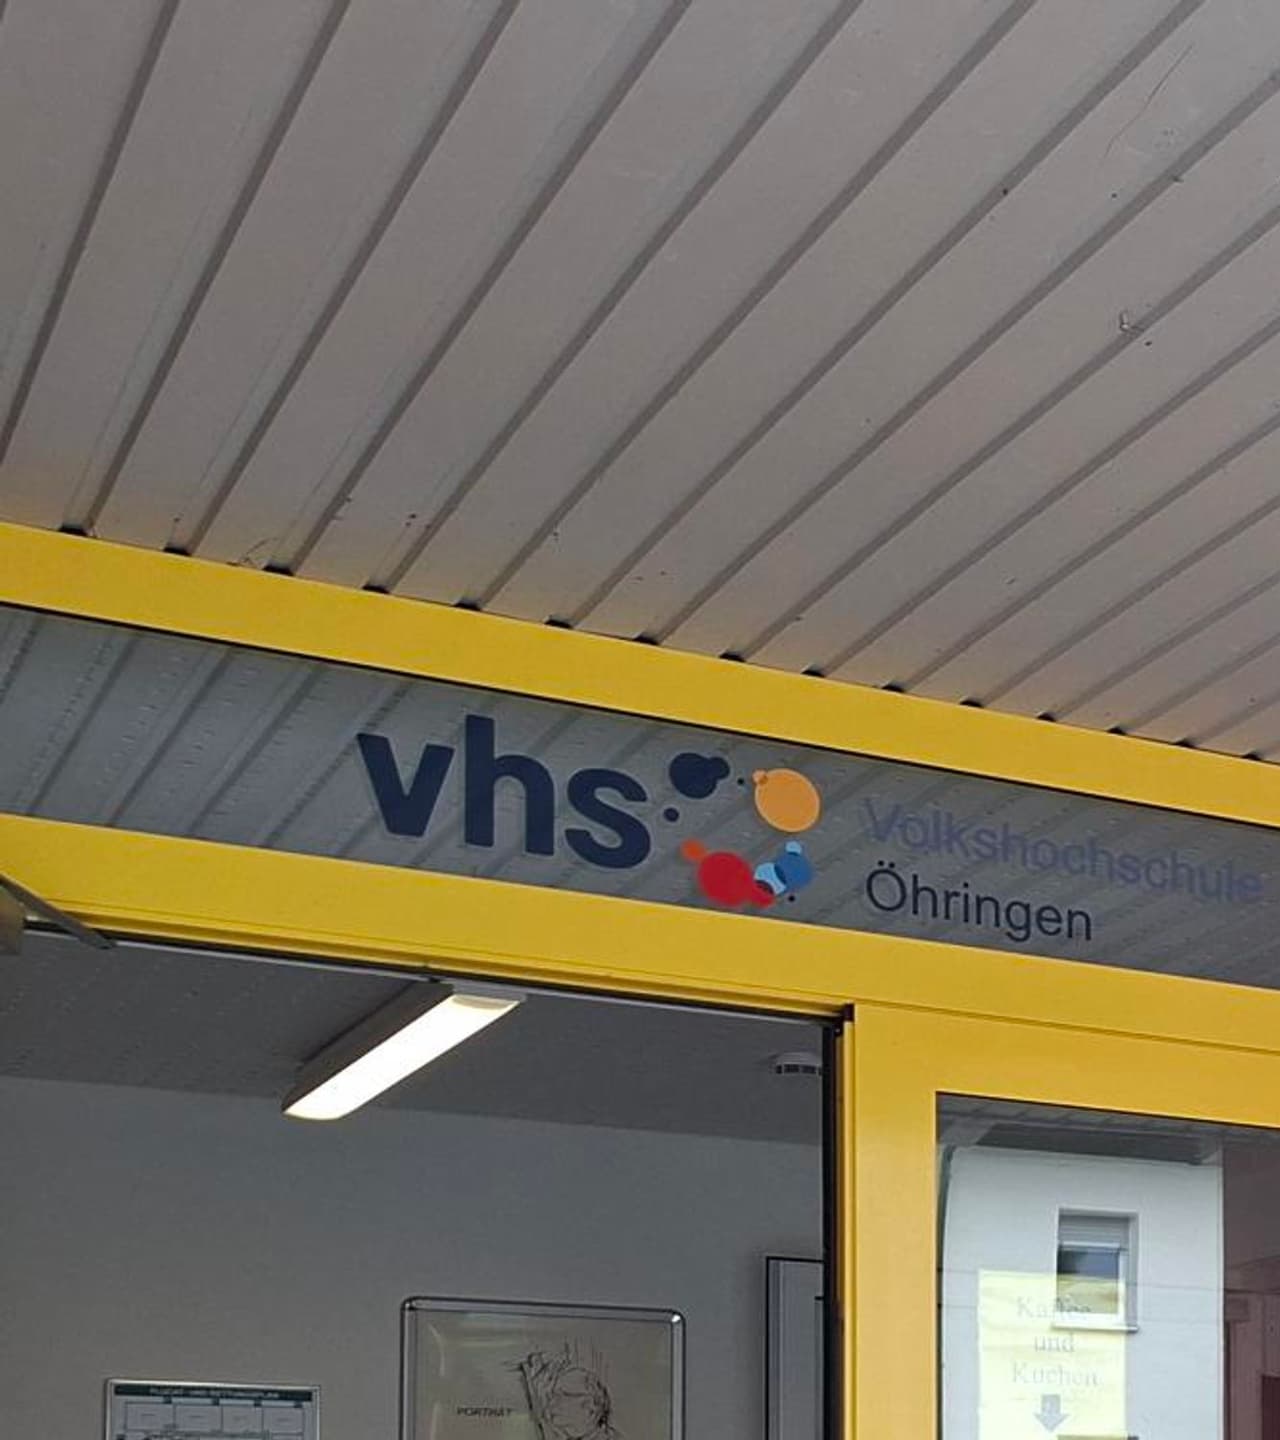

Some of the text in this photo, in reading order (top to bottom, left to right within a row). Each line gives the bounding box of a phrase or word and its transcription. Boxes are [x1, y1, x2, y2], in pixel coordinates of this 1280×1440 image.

[357, 714, 651, 869] vhs
[862, 798, 1262, 900] Volkshochschule
[866, 860, 1092, 942] Öhringen
[1012, 1360, 1101, 1386] Kuchen
[1034, 1332, 1075, 1353] und
